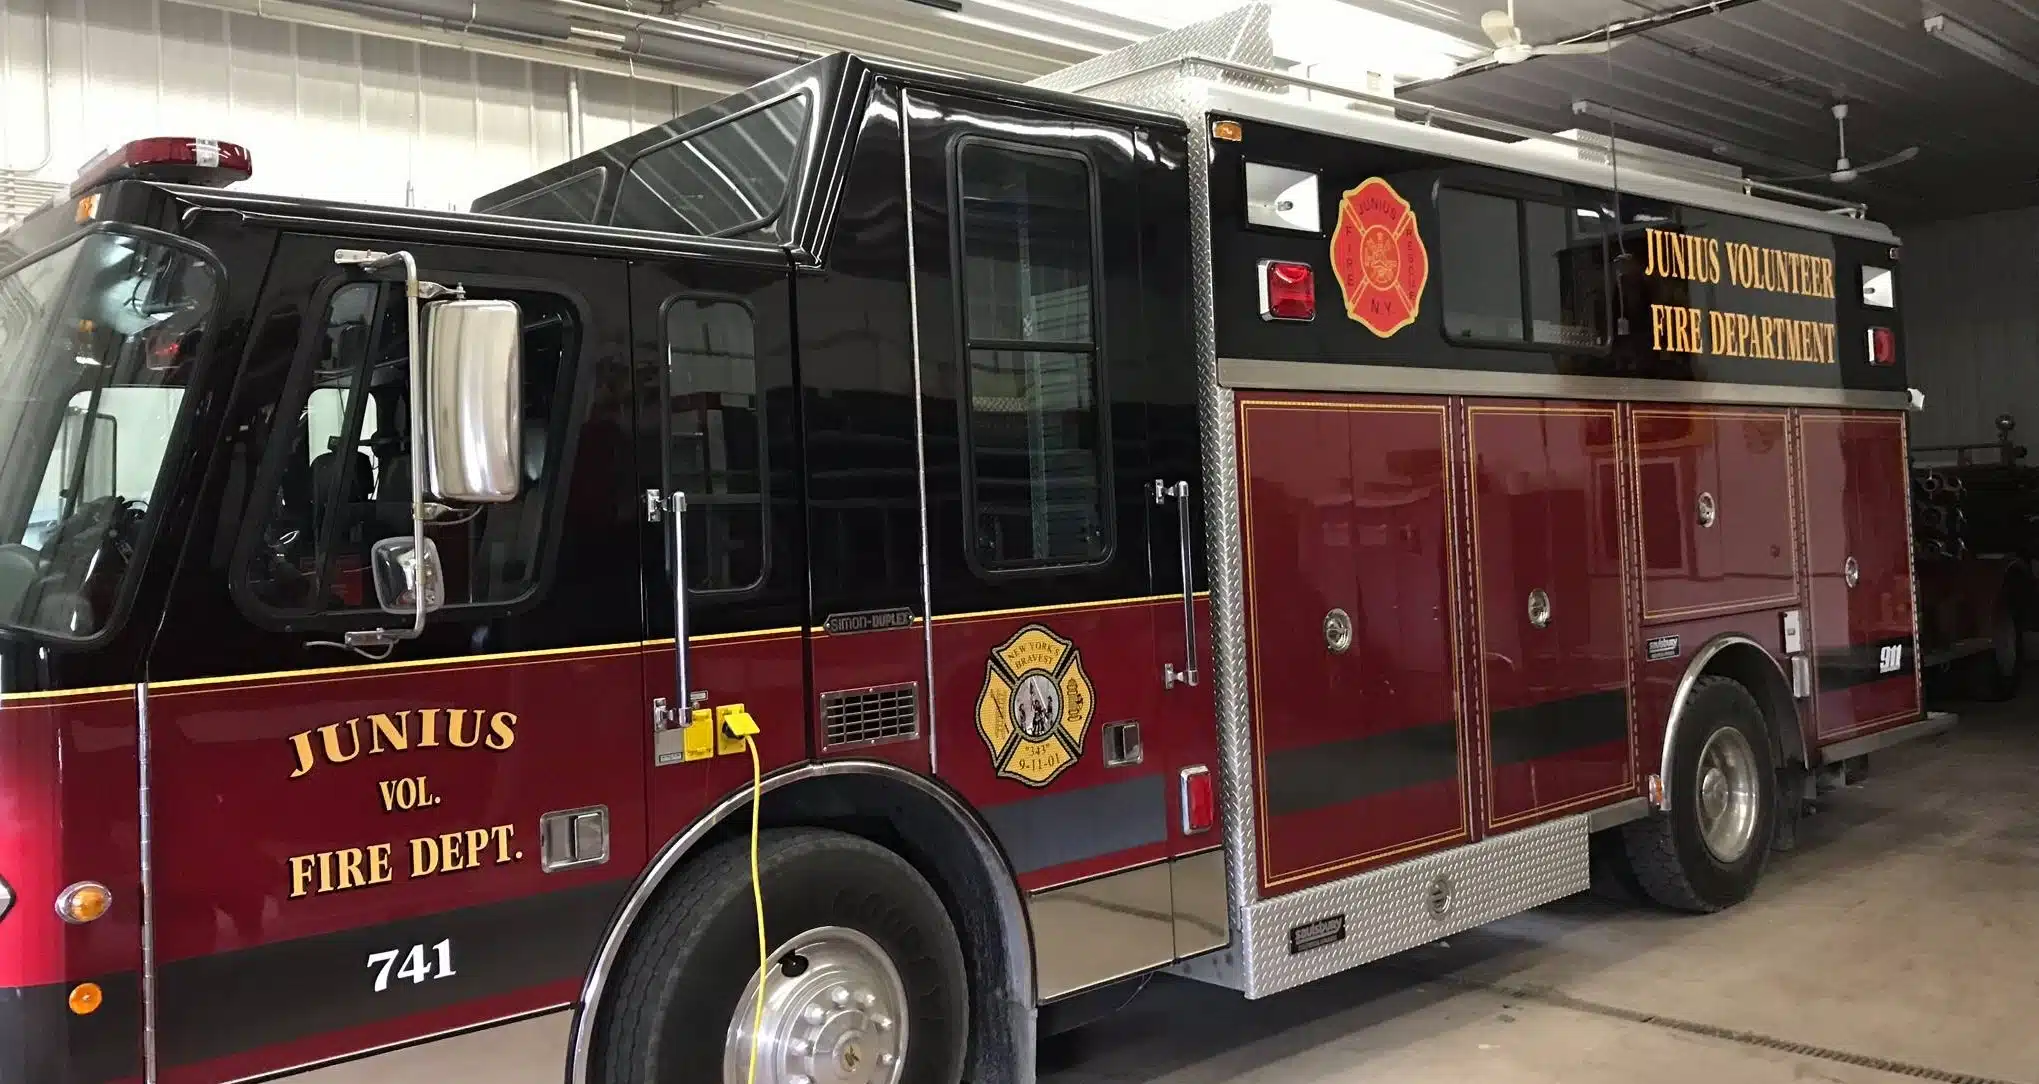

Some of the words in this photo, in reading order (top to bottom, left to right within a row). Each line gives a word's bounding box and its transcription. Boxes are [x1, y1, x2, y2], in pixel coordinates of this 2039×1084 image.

[1358, 198, 1396, 220] JUNIUS
[1345, 226, 1354, 286] FIRE
[1644, 228, 1720, 284] JUNIUS
[1725, 241, 1836, 299] VOLUNTEER
[1650, 303, 1704, 354] FIRE
[1709, 310, 1836, 363] DEPARTMENT
[1007, 644, 1026, 660] NEW
[1029, 641, 1060, 657] YORK'S
[1014, 654, 1054, 670] BRAVEST
[1880, 643, 1902, 673] 911
[289, 708, 518, 778] JUNIUS
[1018, 753, 1061, 772] 9-11-01
[378, 776, 441, 811] VOL.
[289, 842, 394, 898] FIRE
[409, 823, 523, 878] DEPT.
[367, 938, 457, 992] 741
